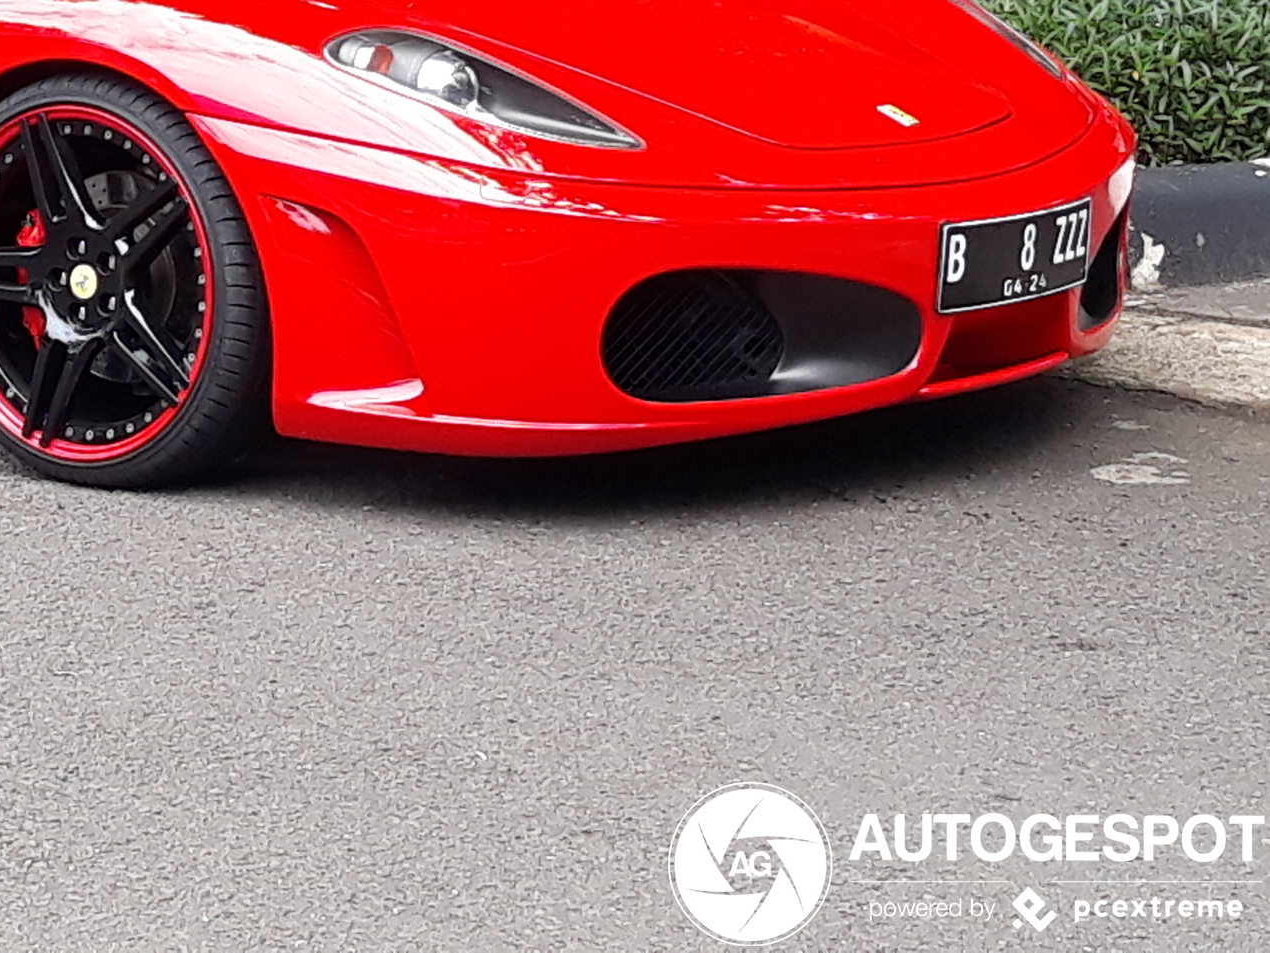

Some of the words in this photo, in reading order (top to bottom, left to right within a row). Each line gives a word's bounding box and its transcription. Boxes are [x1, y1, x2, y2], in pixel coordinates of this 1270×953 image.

[946, 233, 967, 284] B
[1020, 223, 1037, 272] 8
[1052, 208, 1088, 266] ZZZ
